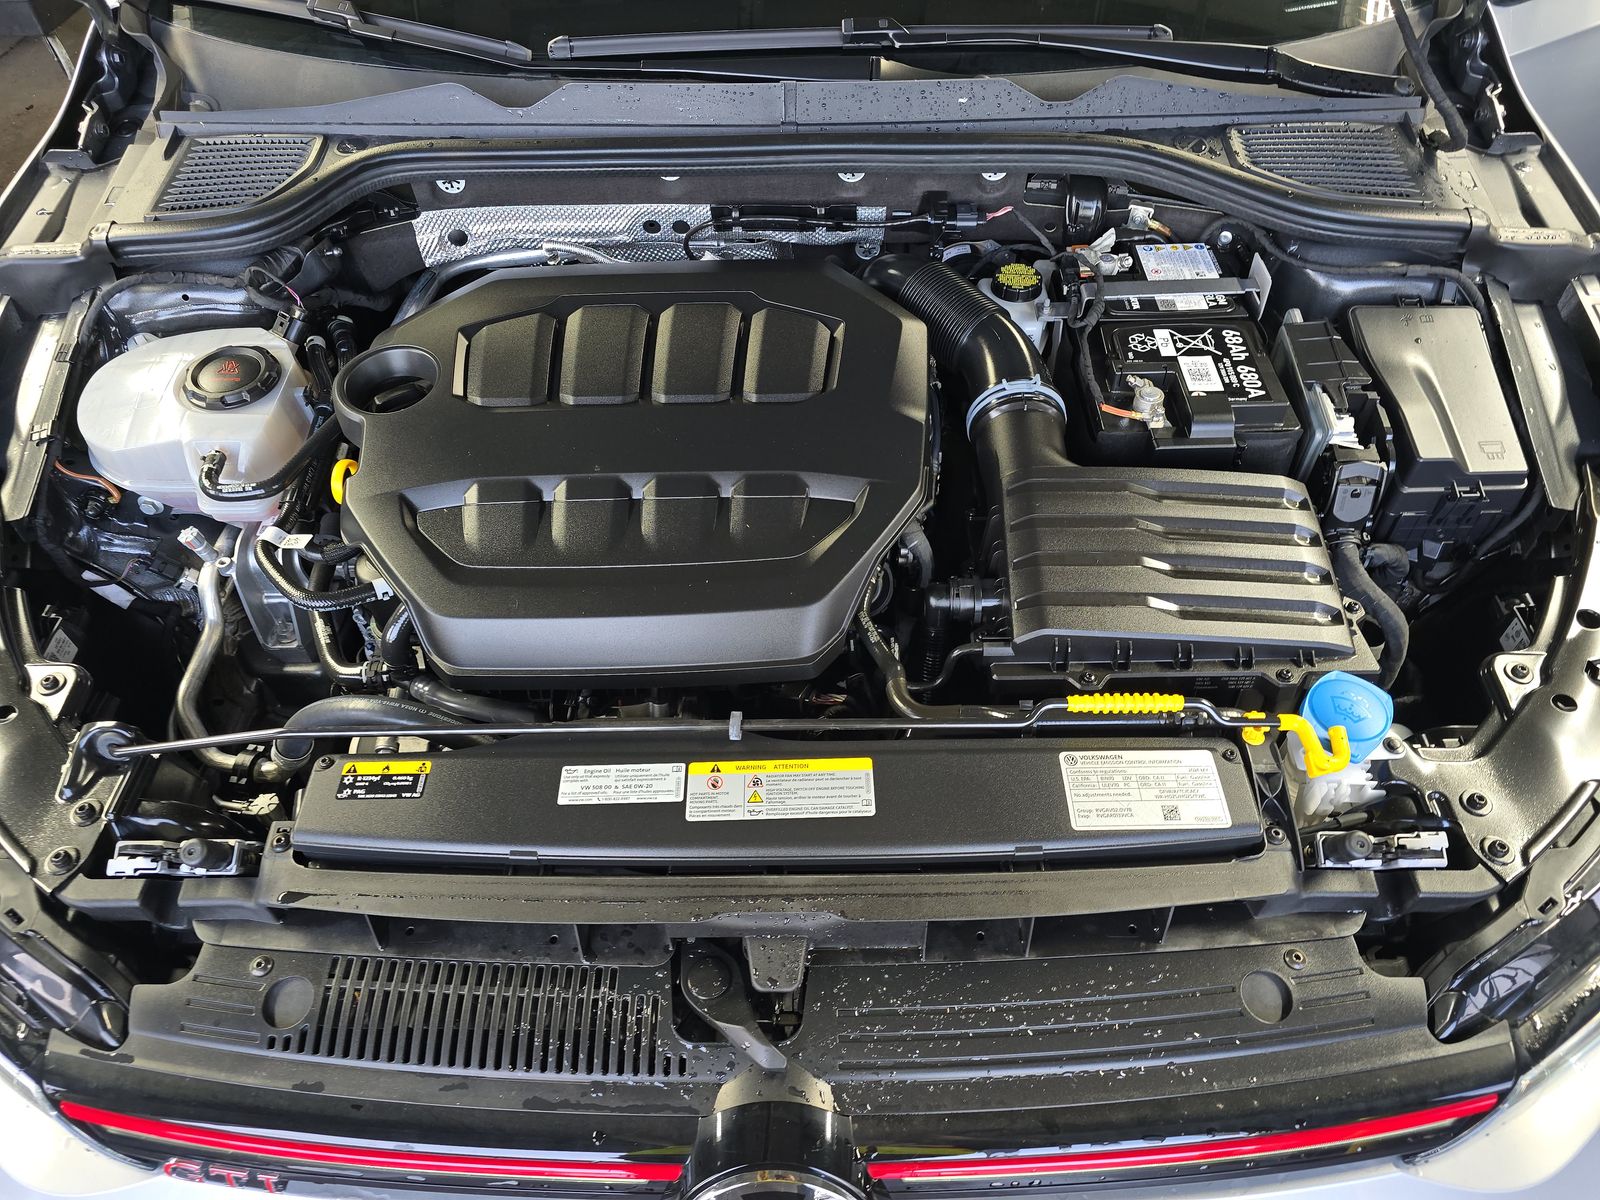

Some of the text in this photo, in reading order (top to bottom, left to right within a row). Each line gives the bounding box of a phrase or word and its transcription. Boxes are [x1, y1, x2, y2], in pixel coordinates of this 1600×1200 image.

[1160, 337, 1170, 348] Pb
[1222, 329, 1249, 361] 68Ah
[1236, 365, 1266, 399] 680A
[162, 1157, 284, 1194] GTI
